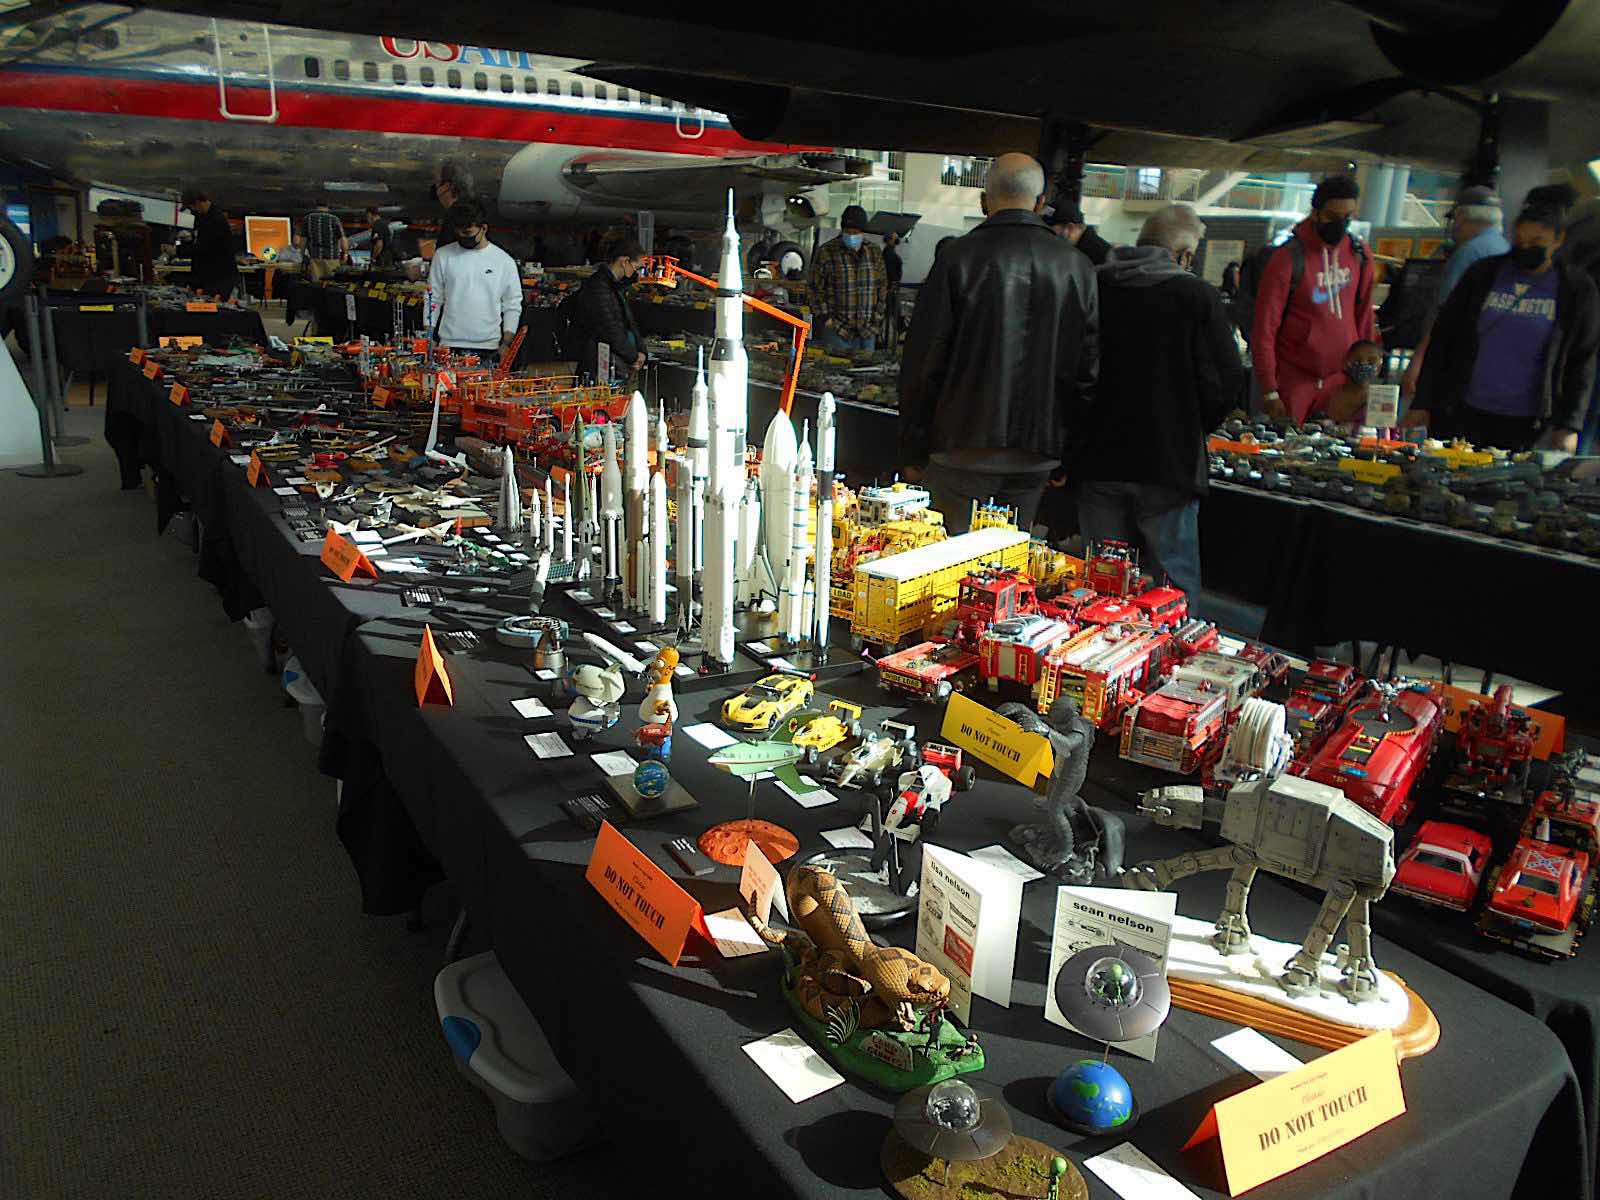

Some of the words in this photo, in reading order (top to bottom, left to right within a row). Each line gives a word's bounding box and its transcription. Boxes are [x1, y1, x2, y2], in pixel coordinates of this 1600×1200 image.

[960, 723, 973, 737] DO
[975, 730, 992, 746] NOT
[992, 739, 1021, 763] TOUCH
[603, 865, 617, 884] DO
[616, 876, 635, 901] NOT
[634, 896, 665, 929] TOUCH
[931, 860, 944, 879] lisa
[944, 874, 970, 900] nelson
[1073, 901, 1105, 918] sean
[1108, 912, 1155, 934] nelson
[1258, 1127, 1281, 1151] DO
[1284, 1109, 1316, 1139] NOT
[1318, 1085, 1368, 1122] TOUCH
